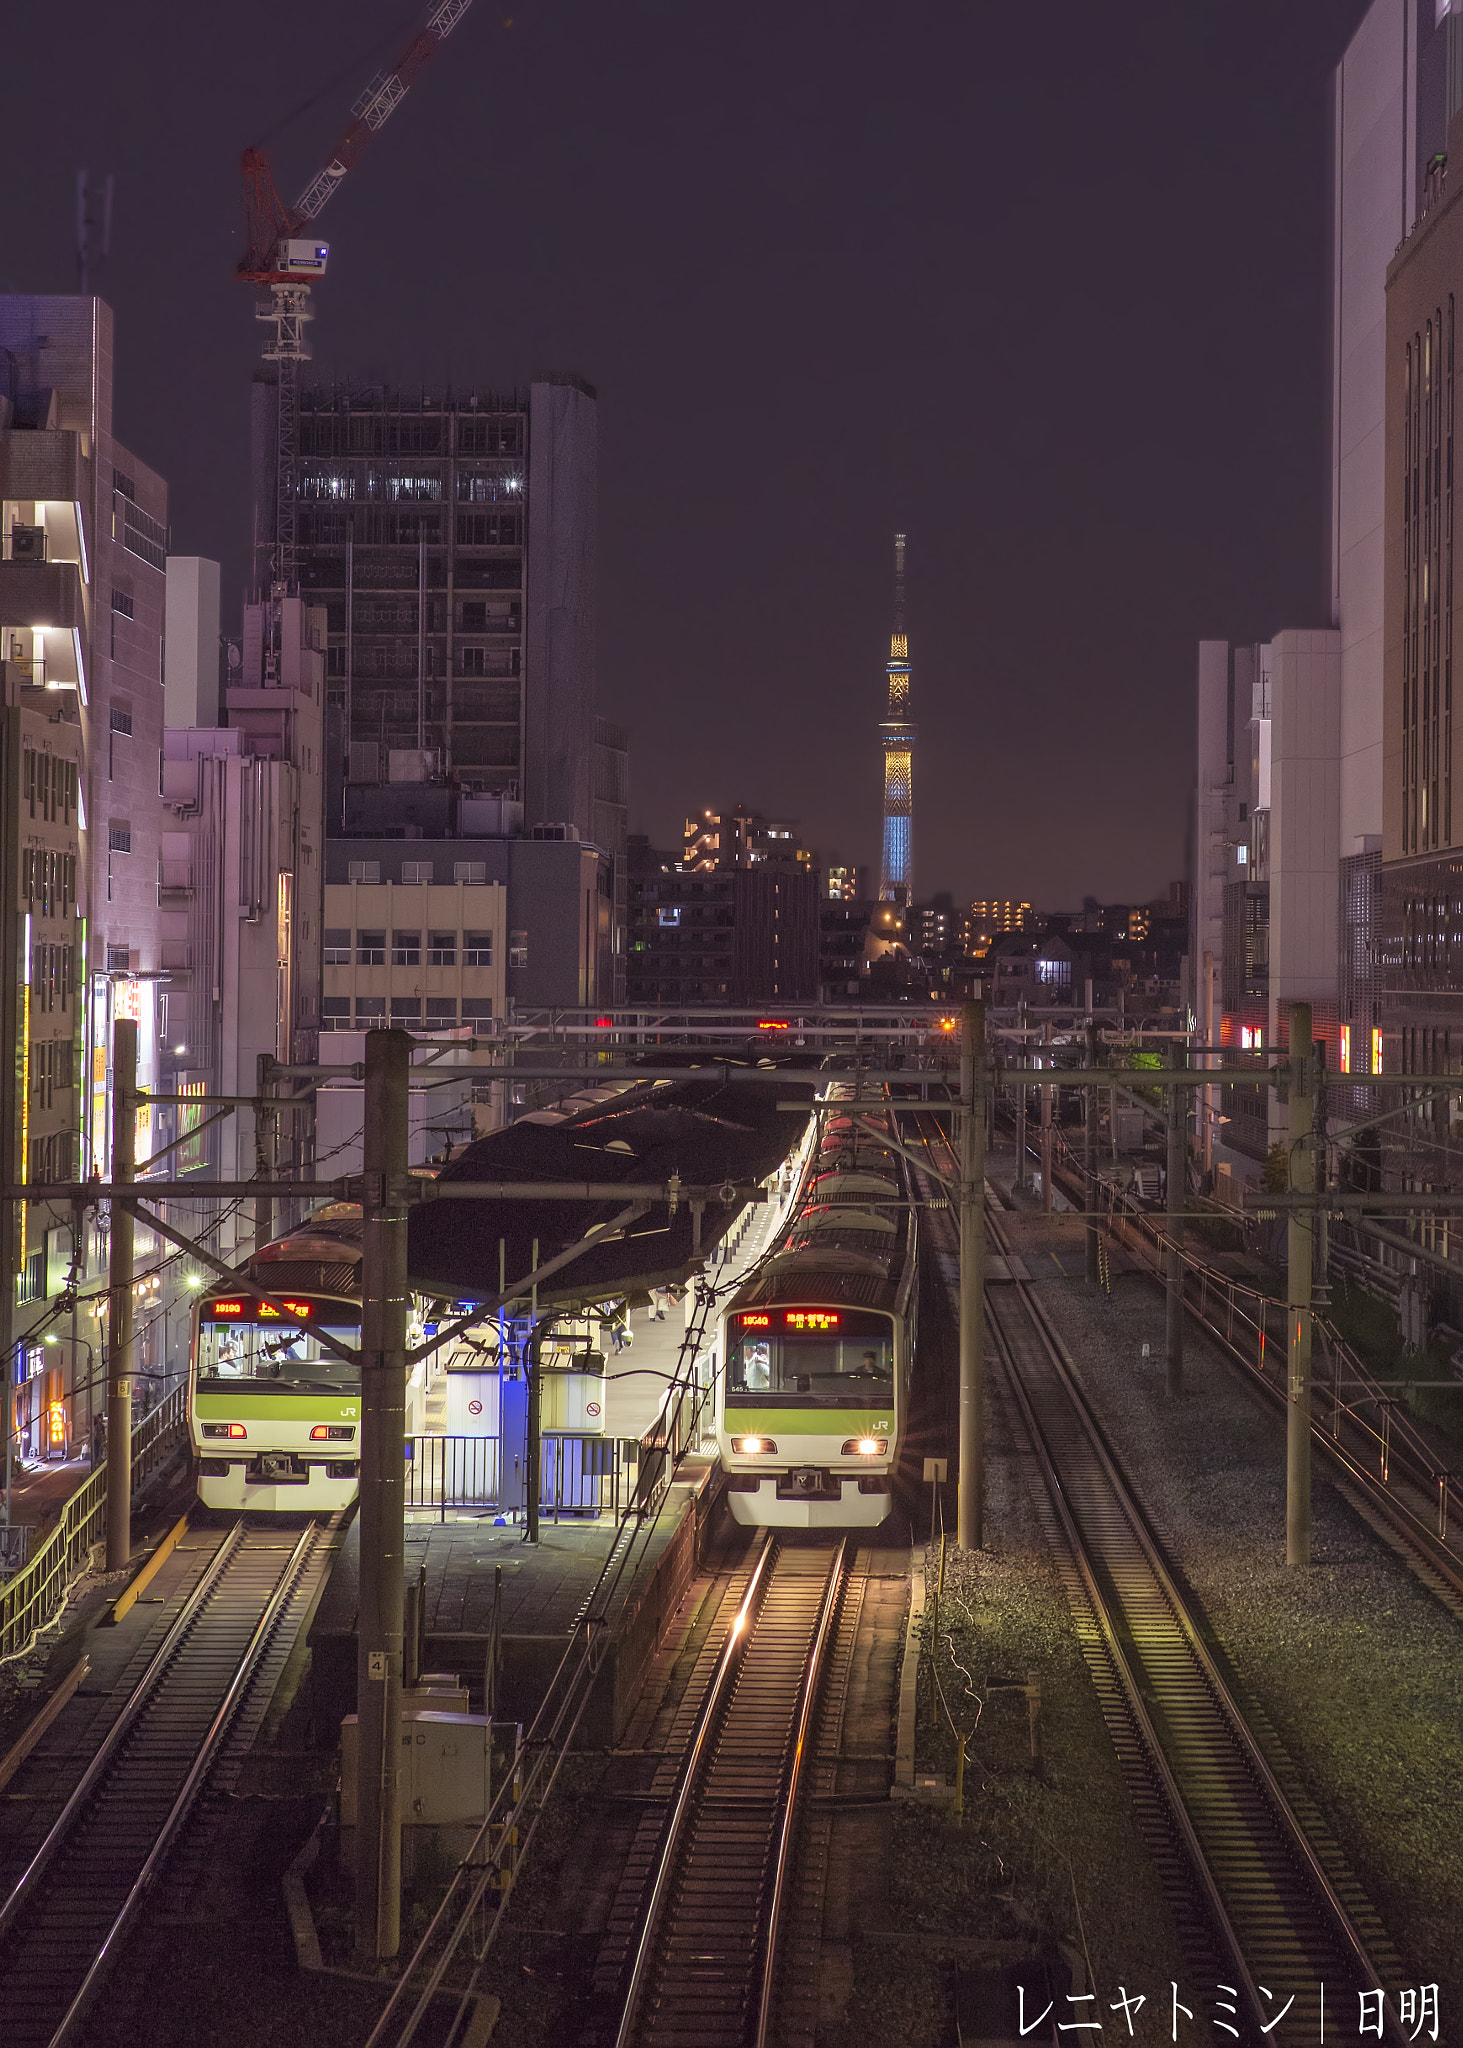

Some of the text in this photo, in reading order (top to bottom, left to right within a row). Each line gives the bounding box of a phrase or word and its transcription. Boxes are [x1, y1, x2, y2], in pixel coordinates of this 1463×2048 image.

[340, 1407, 356, 1417] JR
[872, 1420, 889, 1430] JR
[372, 1661, 382, 1671] 4
